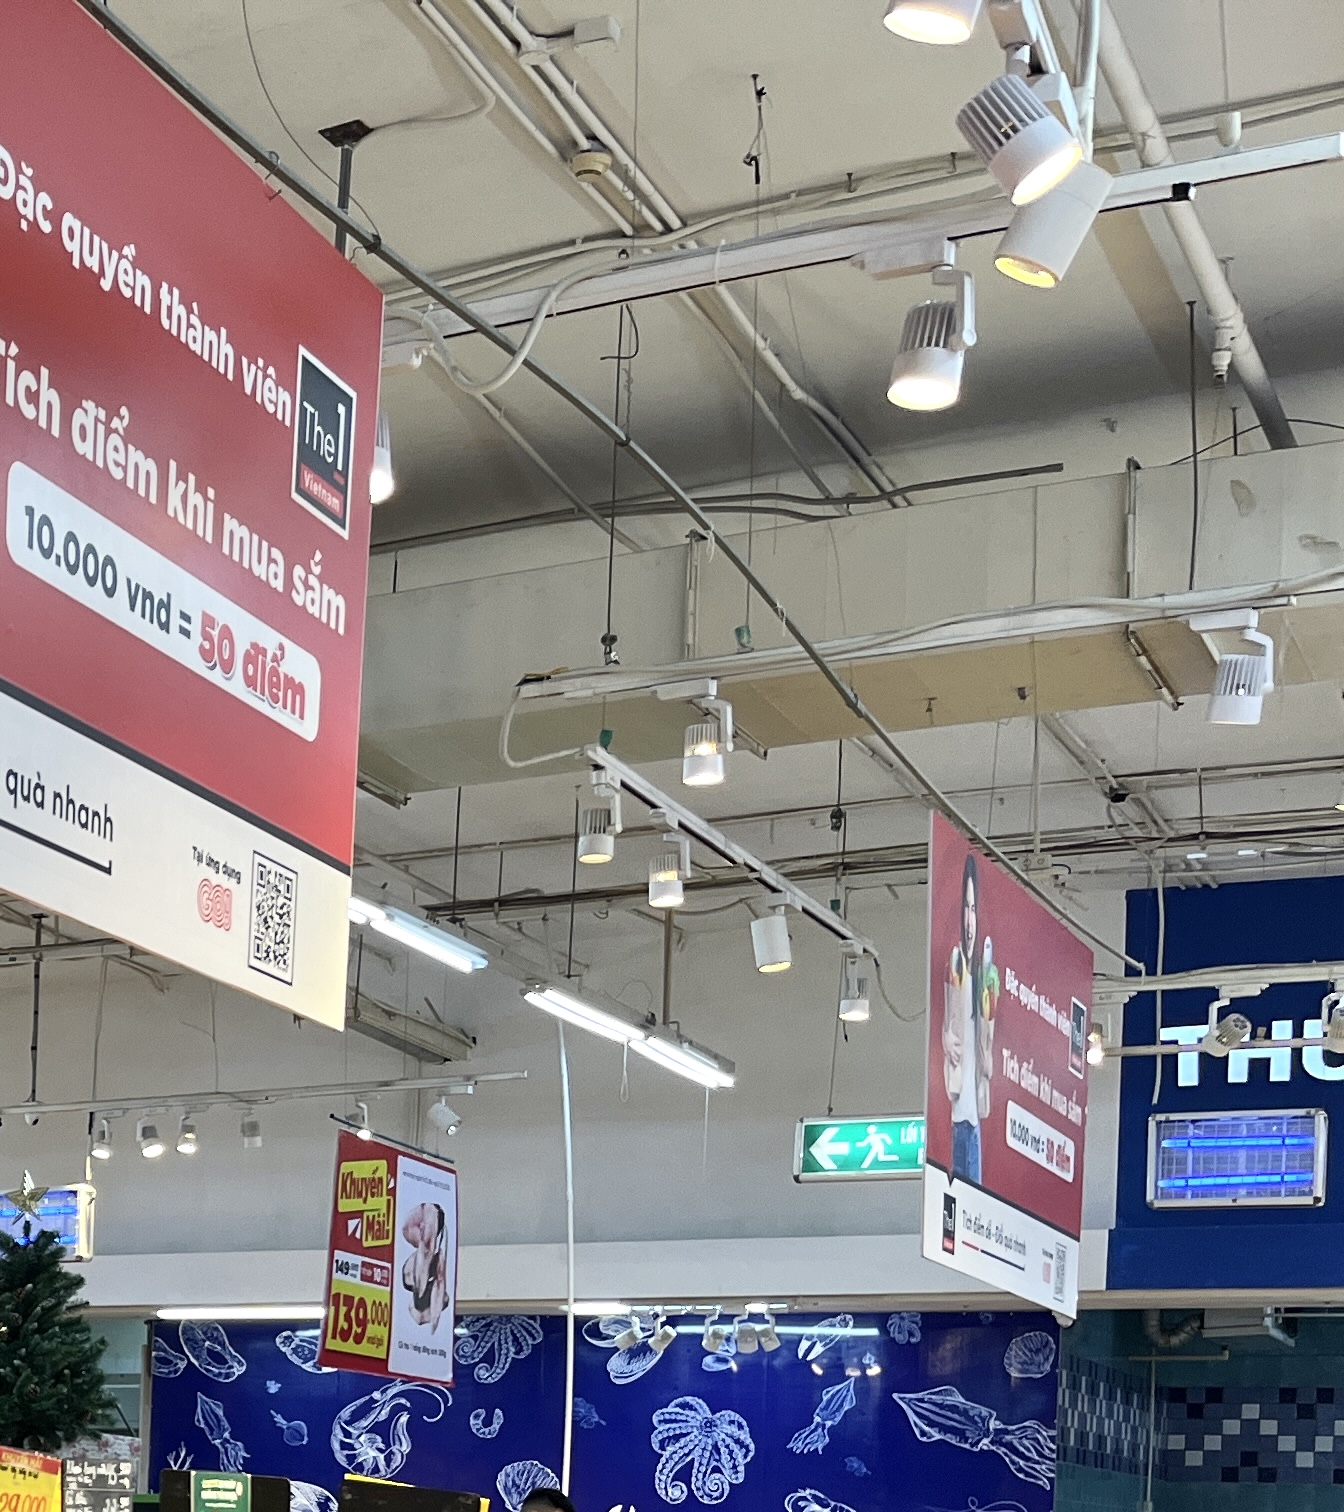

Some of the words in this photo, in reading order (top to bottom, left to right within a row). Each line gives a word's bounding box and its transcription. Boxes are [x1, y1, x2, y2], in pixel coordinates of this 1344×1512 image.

[61, 211, 151, 314] quyền
[160, 280, 234, 381] thành
[242, 356, 292, 428] viên
[71, 398, 157, 504] điểm
[168, 459, 215, 544] khi
[222, 512, 285, 593] mua
[291, 550, 346, 635] sắm
[303, 472, 340, 512] Vietnam
[24, 504, 117, 598] 10.000
[126, 576, 171, 634] vnd
[198, 610, 236, 679] 50
[243, 641, 306, 722] điểm
[6, 771, 45, 807] quà
[53, 785, 113, 841] nhanh
[1002, 1048, 1018, 1081] Tích
[340, 1166, 384, 1204] Khuyến
[331, 1292, 388, 1345] 139.000
